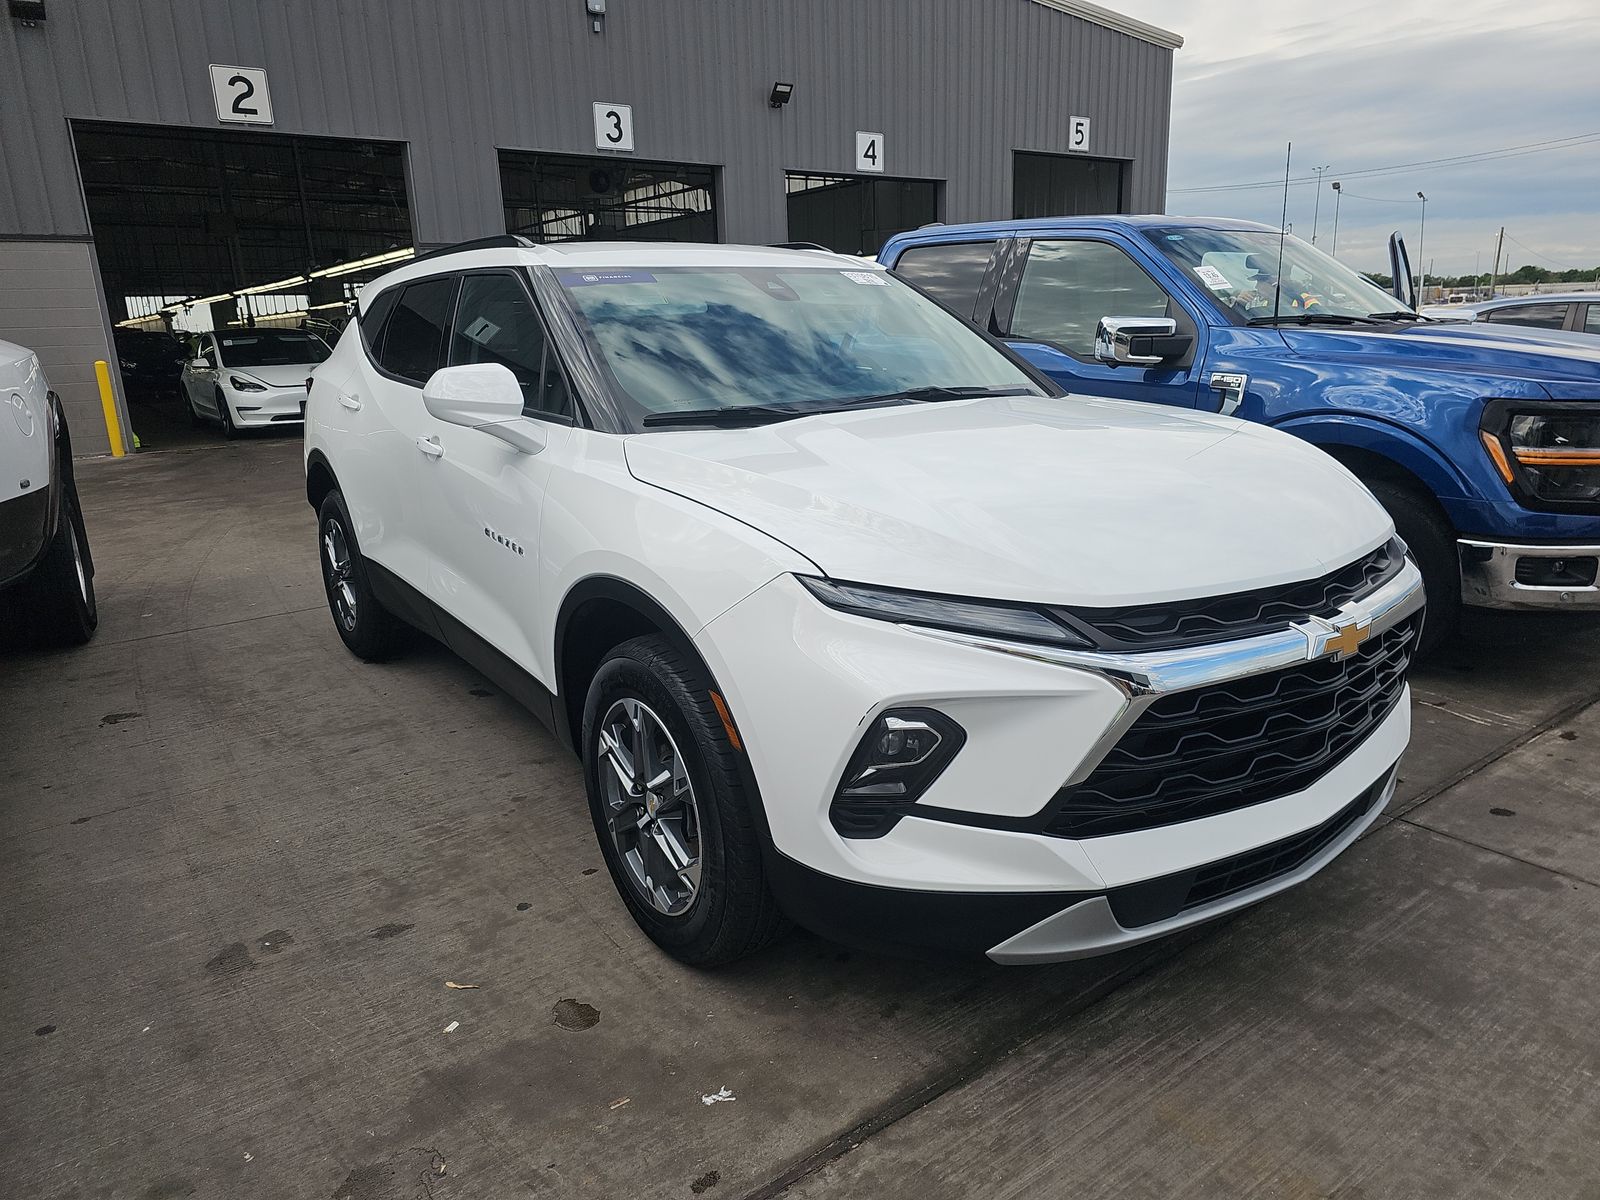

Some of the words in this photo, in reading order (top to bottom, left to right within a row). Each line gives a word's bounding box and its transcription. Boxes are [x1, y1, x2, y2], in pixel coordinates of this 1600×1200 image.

[228, 76, 258, 115] 2
[606, 111, 623, 143] 3
[1075, 122, 1084, 145] 5
[863, 140, 877, 166] 4
[1212, 375, 1242, 383] F-150
[484, 527, 524, 556] BLAZER
